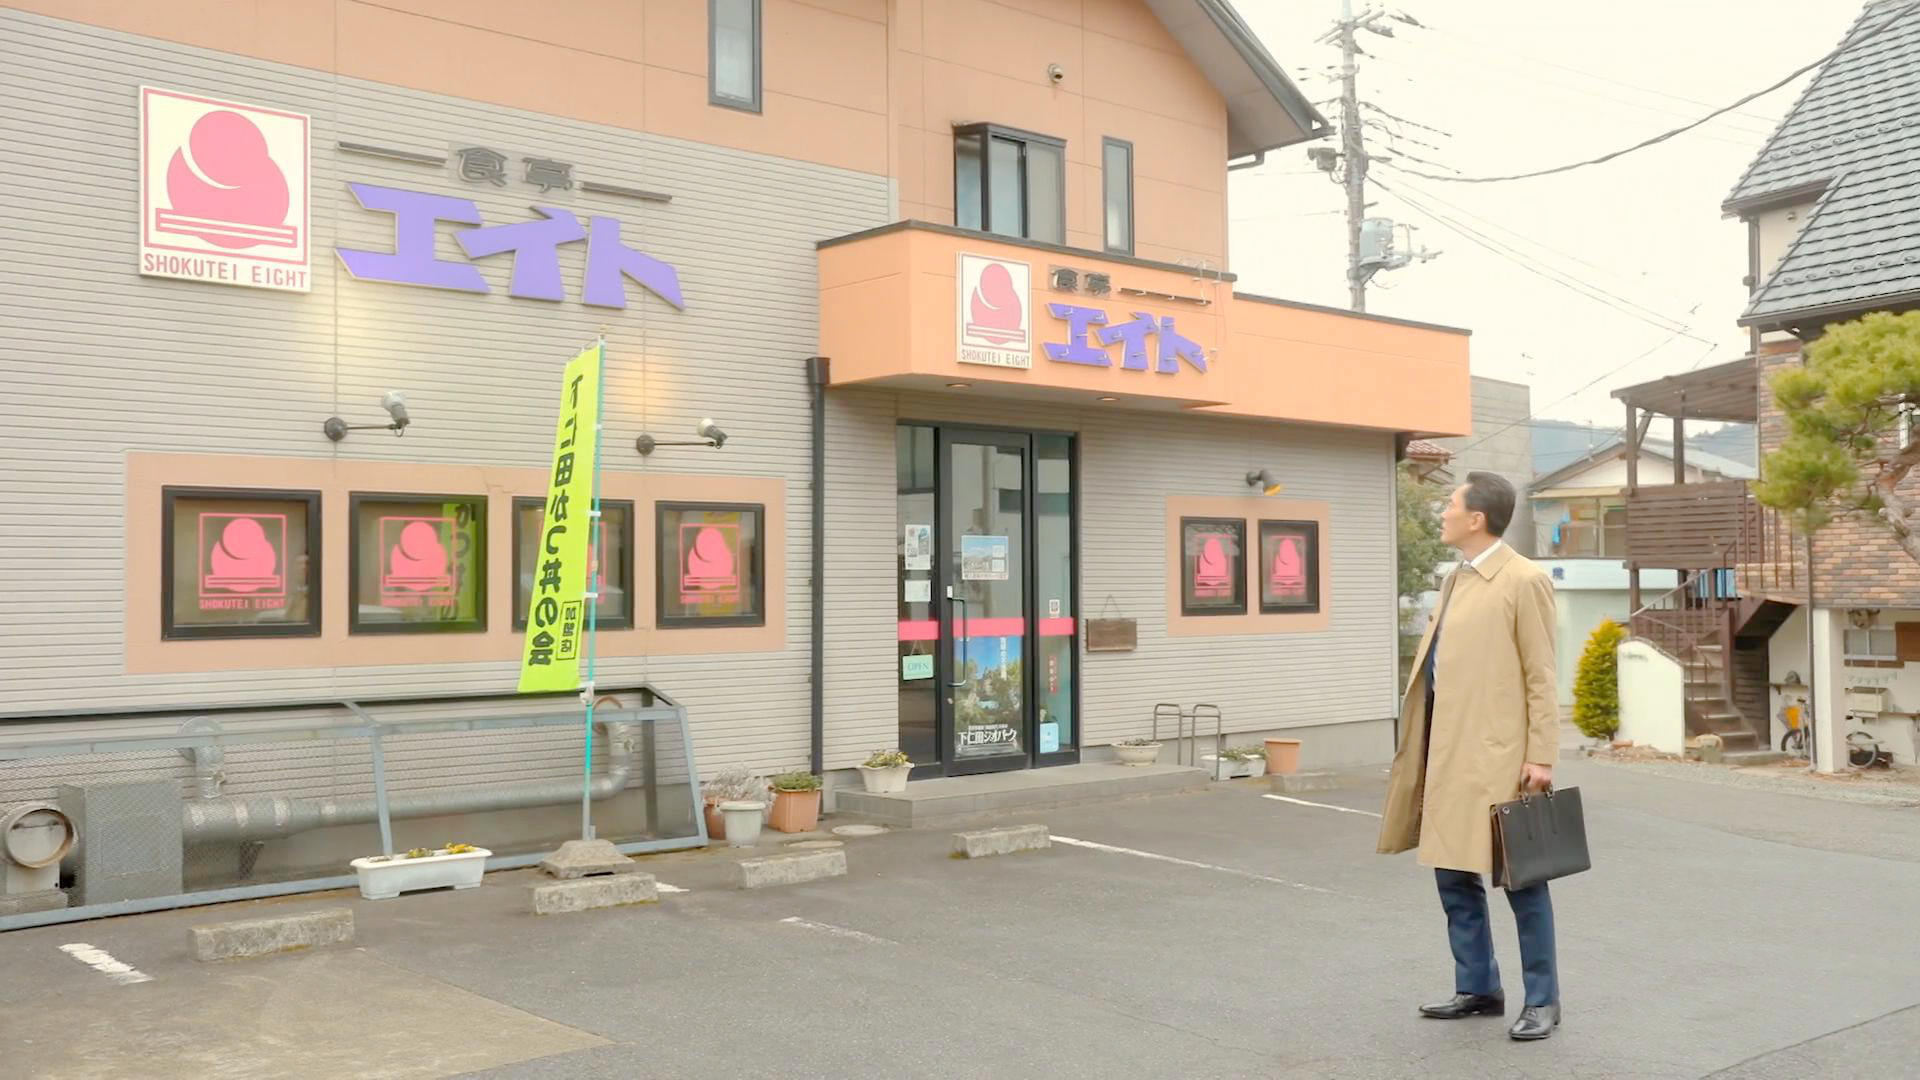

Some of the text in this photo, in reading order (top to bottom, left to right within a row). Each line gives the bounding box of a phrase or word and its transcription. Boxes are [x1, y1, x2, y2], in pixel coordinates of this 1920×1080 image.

[454, 147, 574, 194] 食亭
[334, 181, 686, 312] エイト
[144, 252, 307, 288] SHOKUTEI EIGHT
[961, 349, 1030, 366] SHOKUTEI EIGHT
[1040, 302, 1208, 374] エイト
[907, 663, 929, 671] OPEN
